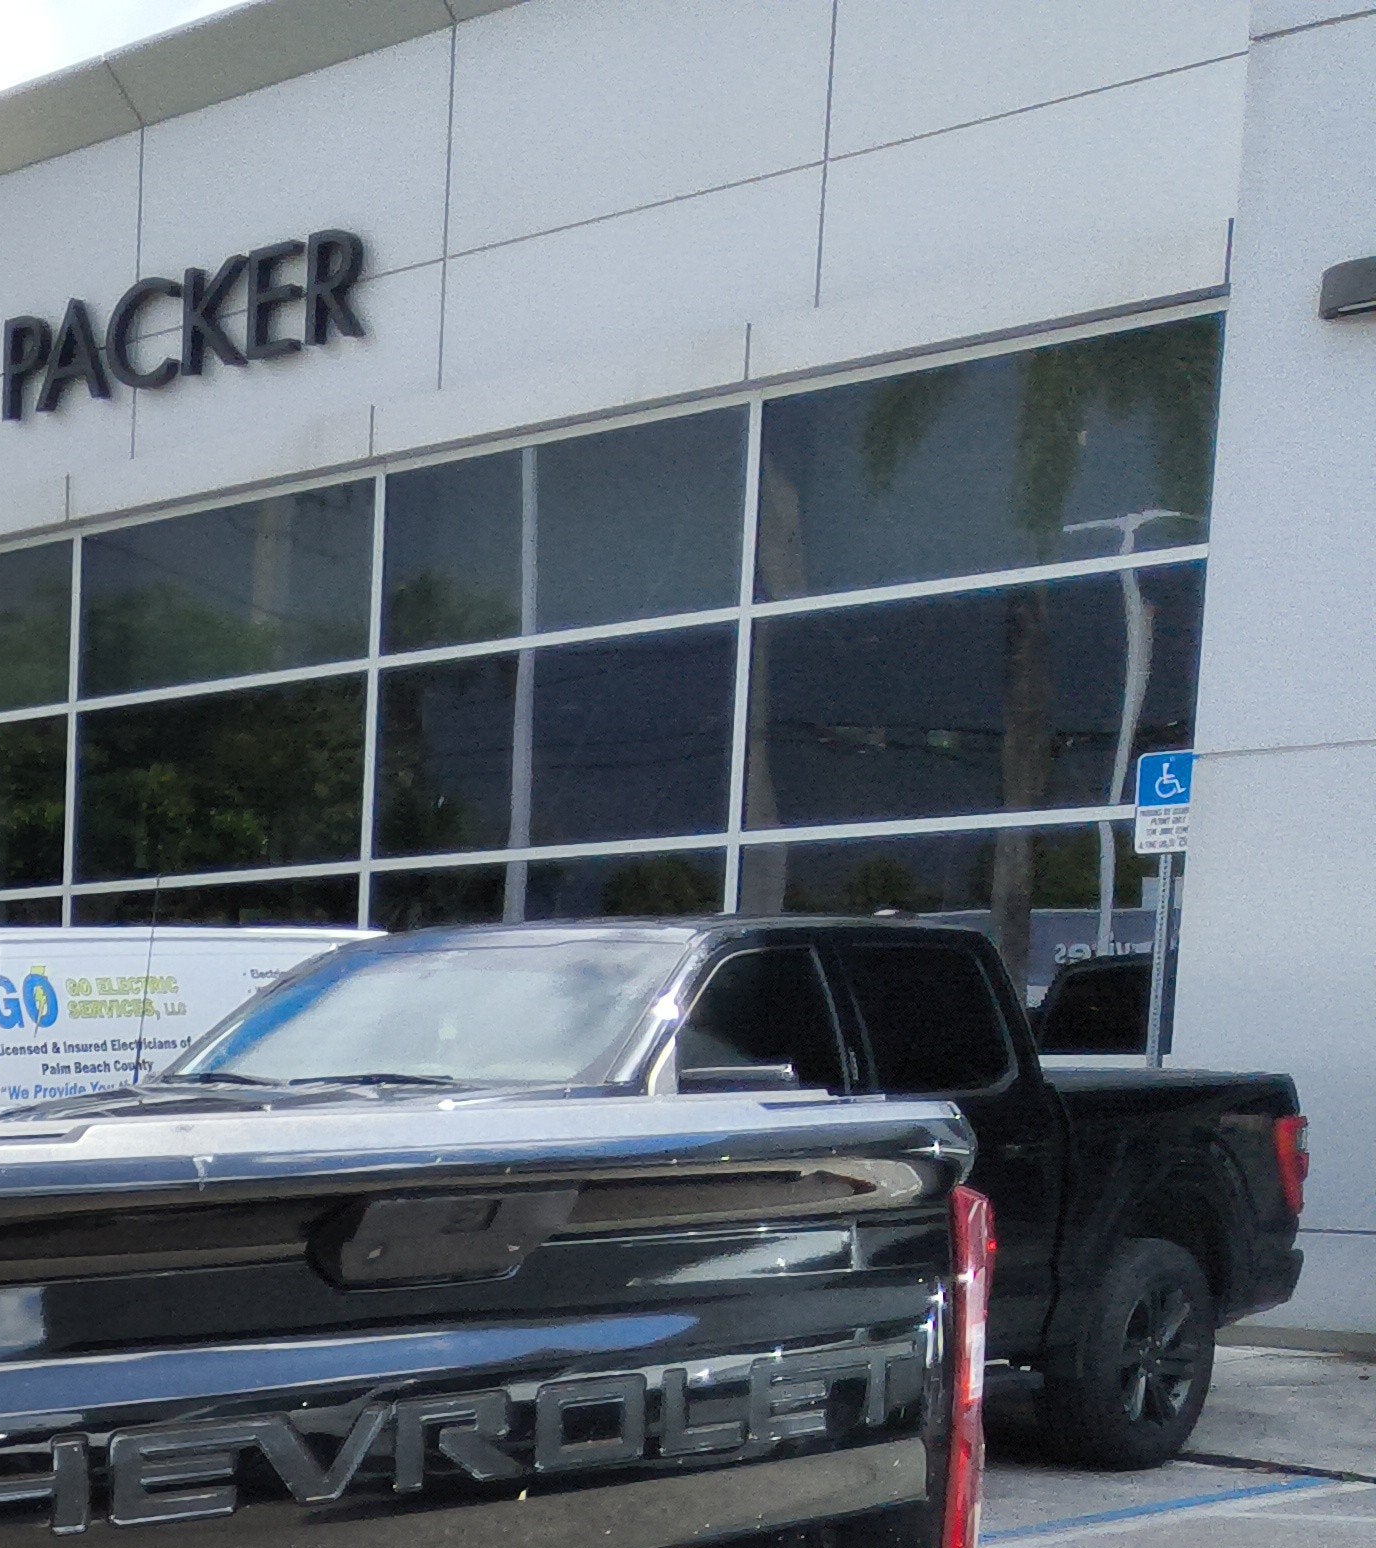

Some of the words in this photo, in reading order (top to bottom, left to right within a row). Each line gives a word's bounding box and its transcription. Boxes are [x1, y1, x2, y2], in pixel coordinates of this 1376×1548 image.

[1, 228, 367, 421] PACKER
[65, 978, 92, 996] GO
[96, 976, 179, 995] ELECTRIC
[52, 1042, 60, 1054] &
[64, 1040, 107, 1054] Insured
[110, 1037, 177, 1051] Electricians
[179, 1036, 191, 1049] of
[42, 1063, 71, 1075] Palm
[74, 1059, 110, 1074] Beach
[114, 1058, 154, 1073] County
